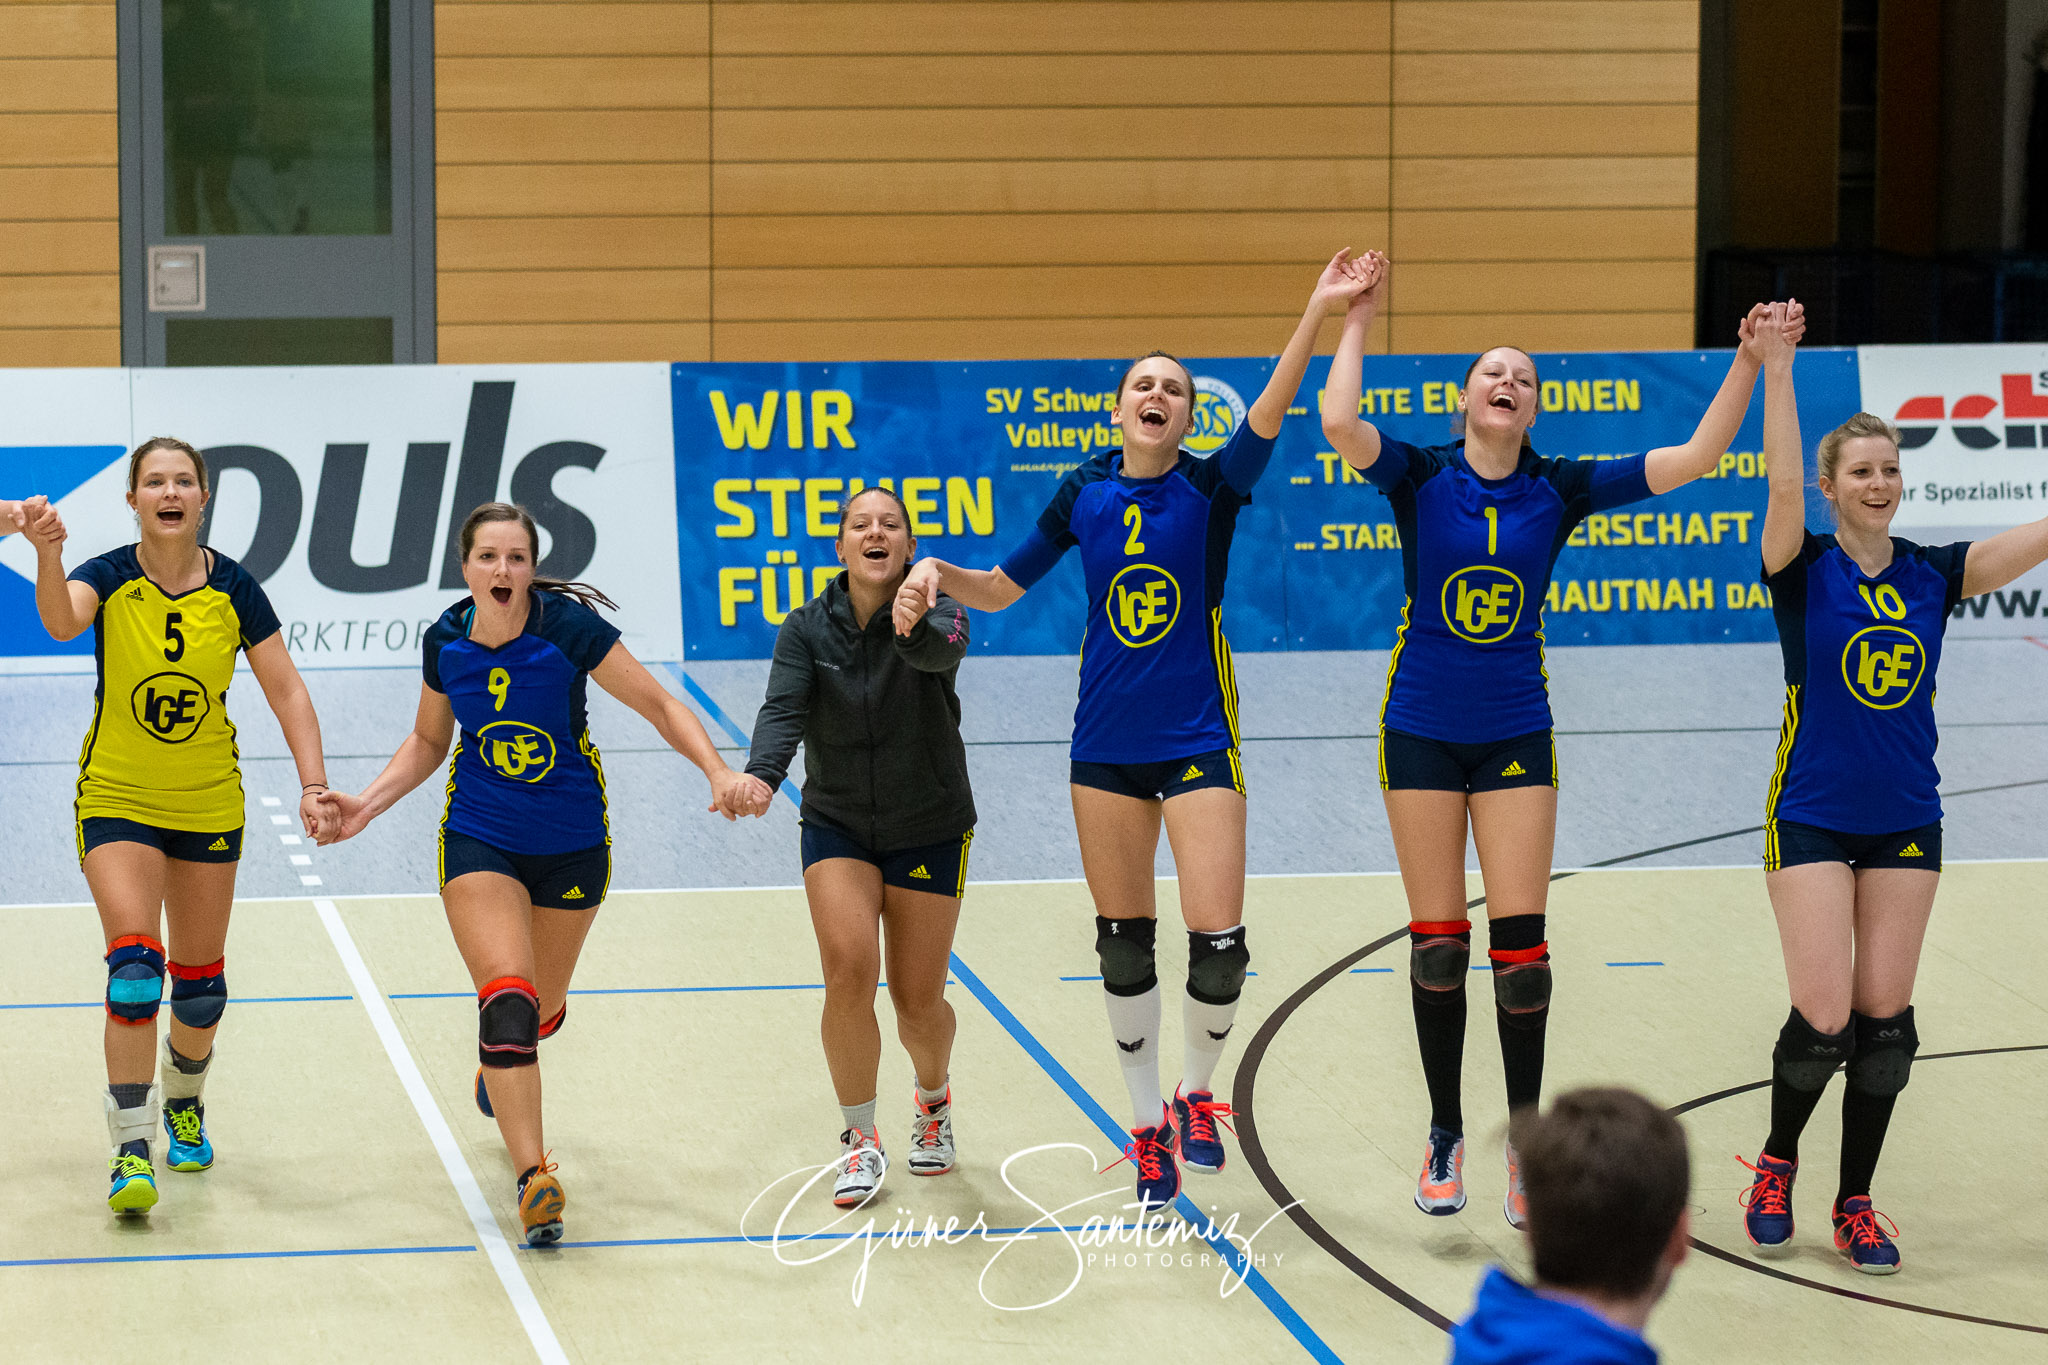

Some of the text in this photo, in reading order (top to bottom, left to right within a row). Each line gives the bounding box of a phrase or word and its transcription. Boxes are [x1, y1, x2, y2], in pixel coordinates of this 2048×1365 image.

[986, 387, 1118, 413] SV Schwa
[1318, 388, 1411, 414] HTE
[1423, 379, 1642, 414] EMONEN
[709, 390, 857, 451] WIR
[1005, 422, 1124, 453] Volleyba
[712, 476, 995, 538] STEEN
[1924, 481, 2034, 505] Spezialist
[1124, 503, 1145, 556] 2
[1321, 523, 1402, 550] STAR
[1566, 511, 1753, 547] ERSCHAFT
[1484, 507, 1497, 556] 1
[1116, 580, 1168, 637] IGE
[1455, 579, 1514, 633] IGE
[1726, 582, 1773, 609] DA
[1858, 583, 1907, 620] 10
[163, 612, 185, 662] 5
[488, 667, 511, 711] 9
[1857, 641, 1915, 697] IGE
[144, 687, 200, 734] IGE
